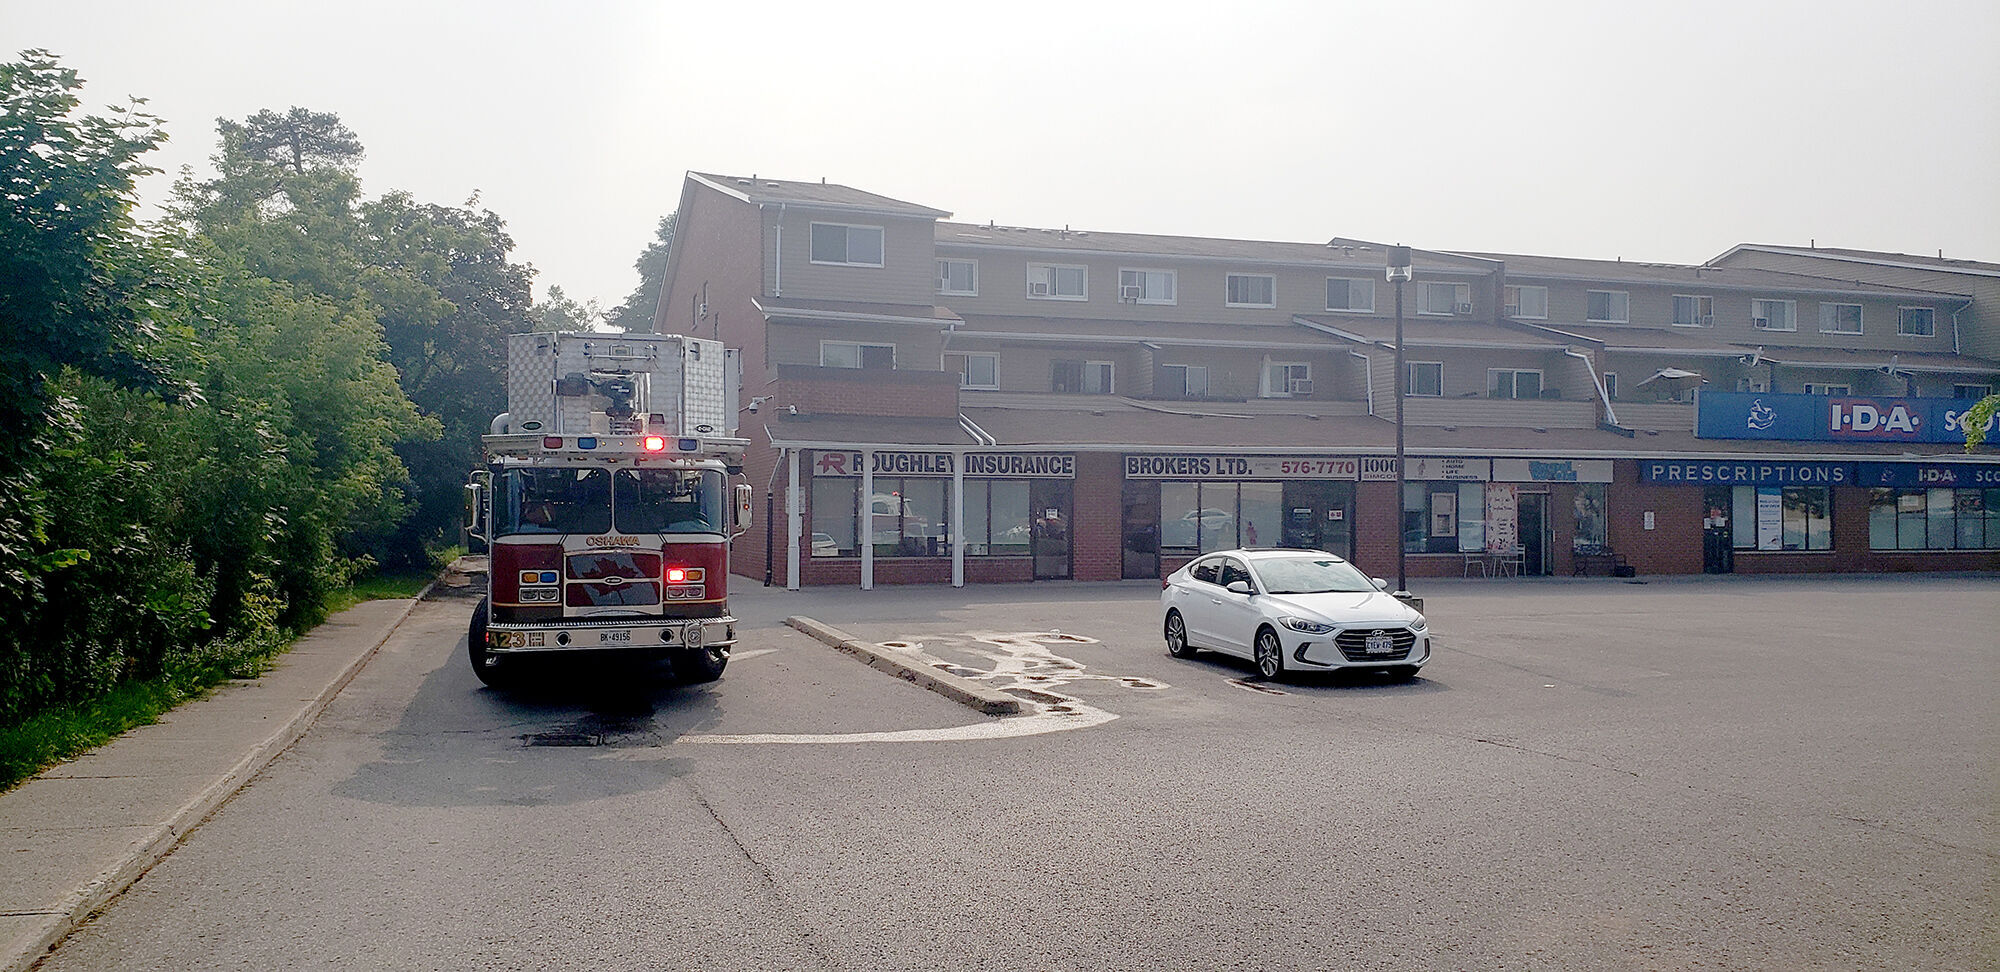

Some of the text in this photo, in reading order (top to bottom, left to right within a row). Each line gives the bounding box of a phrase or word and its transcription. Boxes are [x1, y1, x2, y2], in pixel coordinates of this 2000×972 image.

[965, 455, 1073, 474] INSURANCE
[1128, 457, 1210, 475] BROKERS
[1216, 458, 1253, 475] LTD.
[1281, 461, 1355, 474] 576-7770
[1651, 465, 1844, 482] PRESCRIPTIONS
[585, 535, 640, 546] OSHAWA
[489, 631, 526, 648] A23
